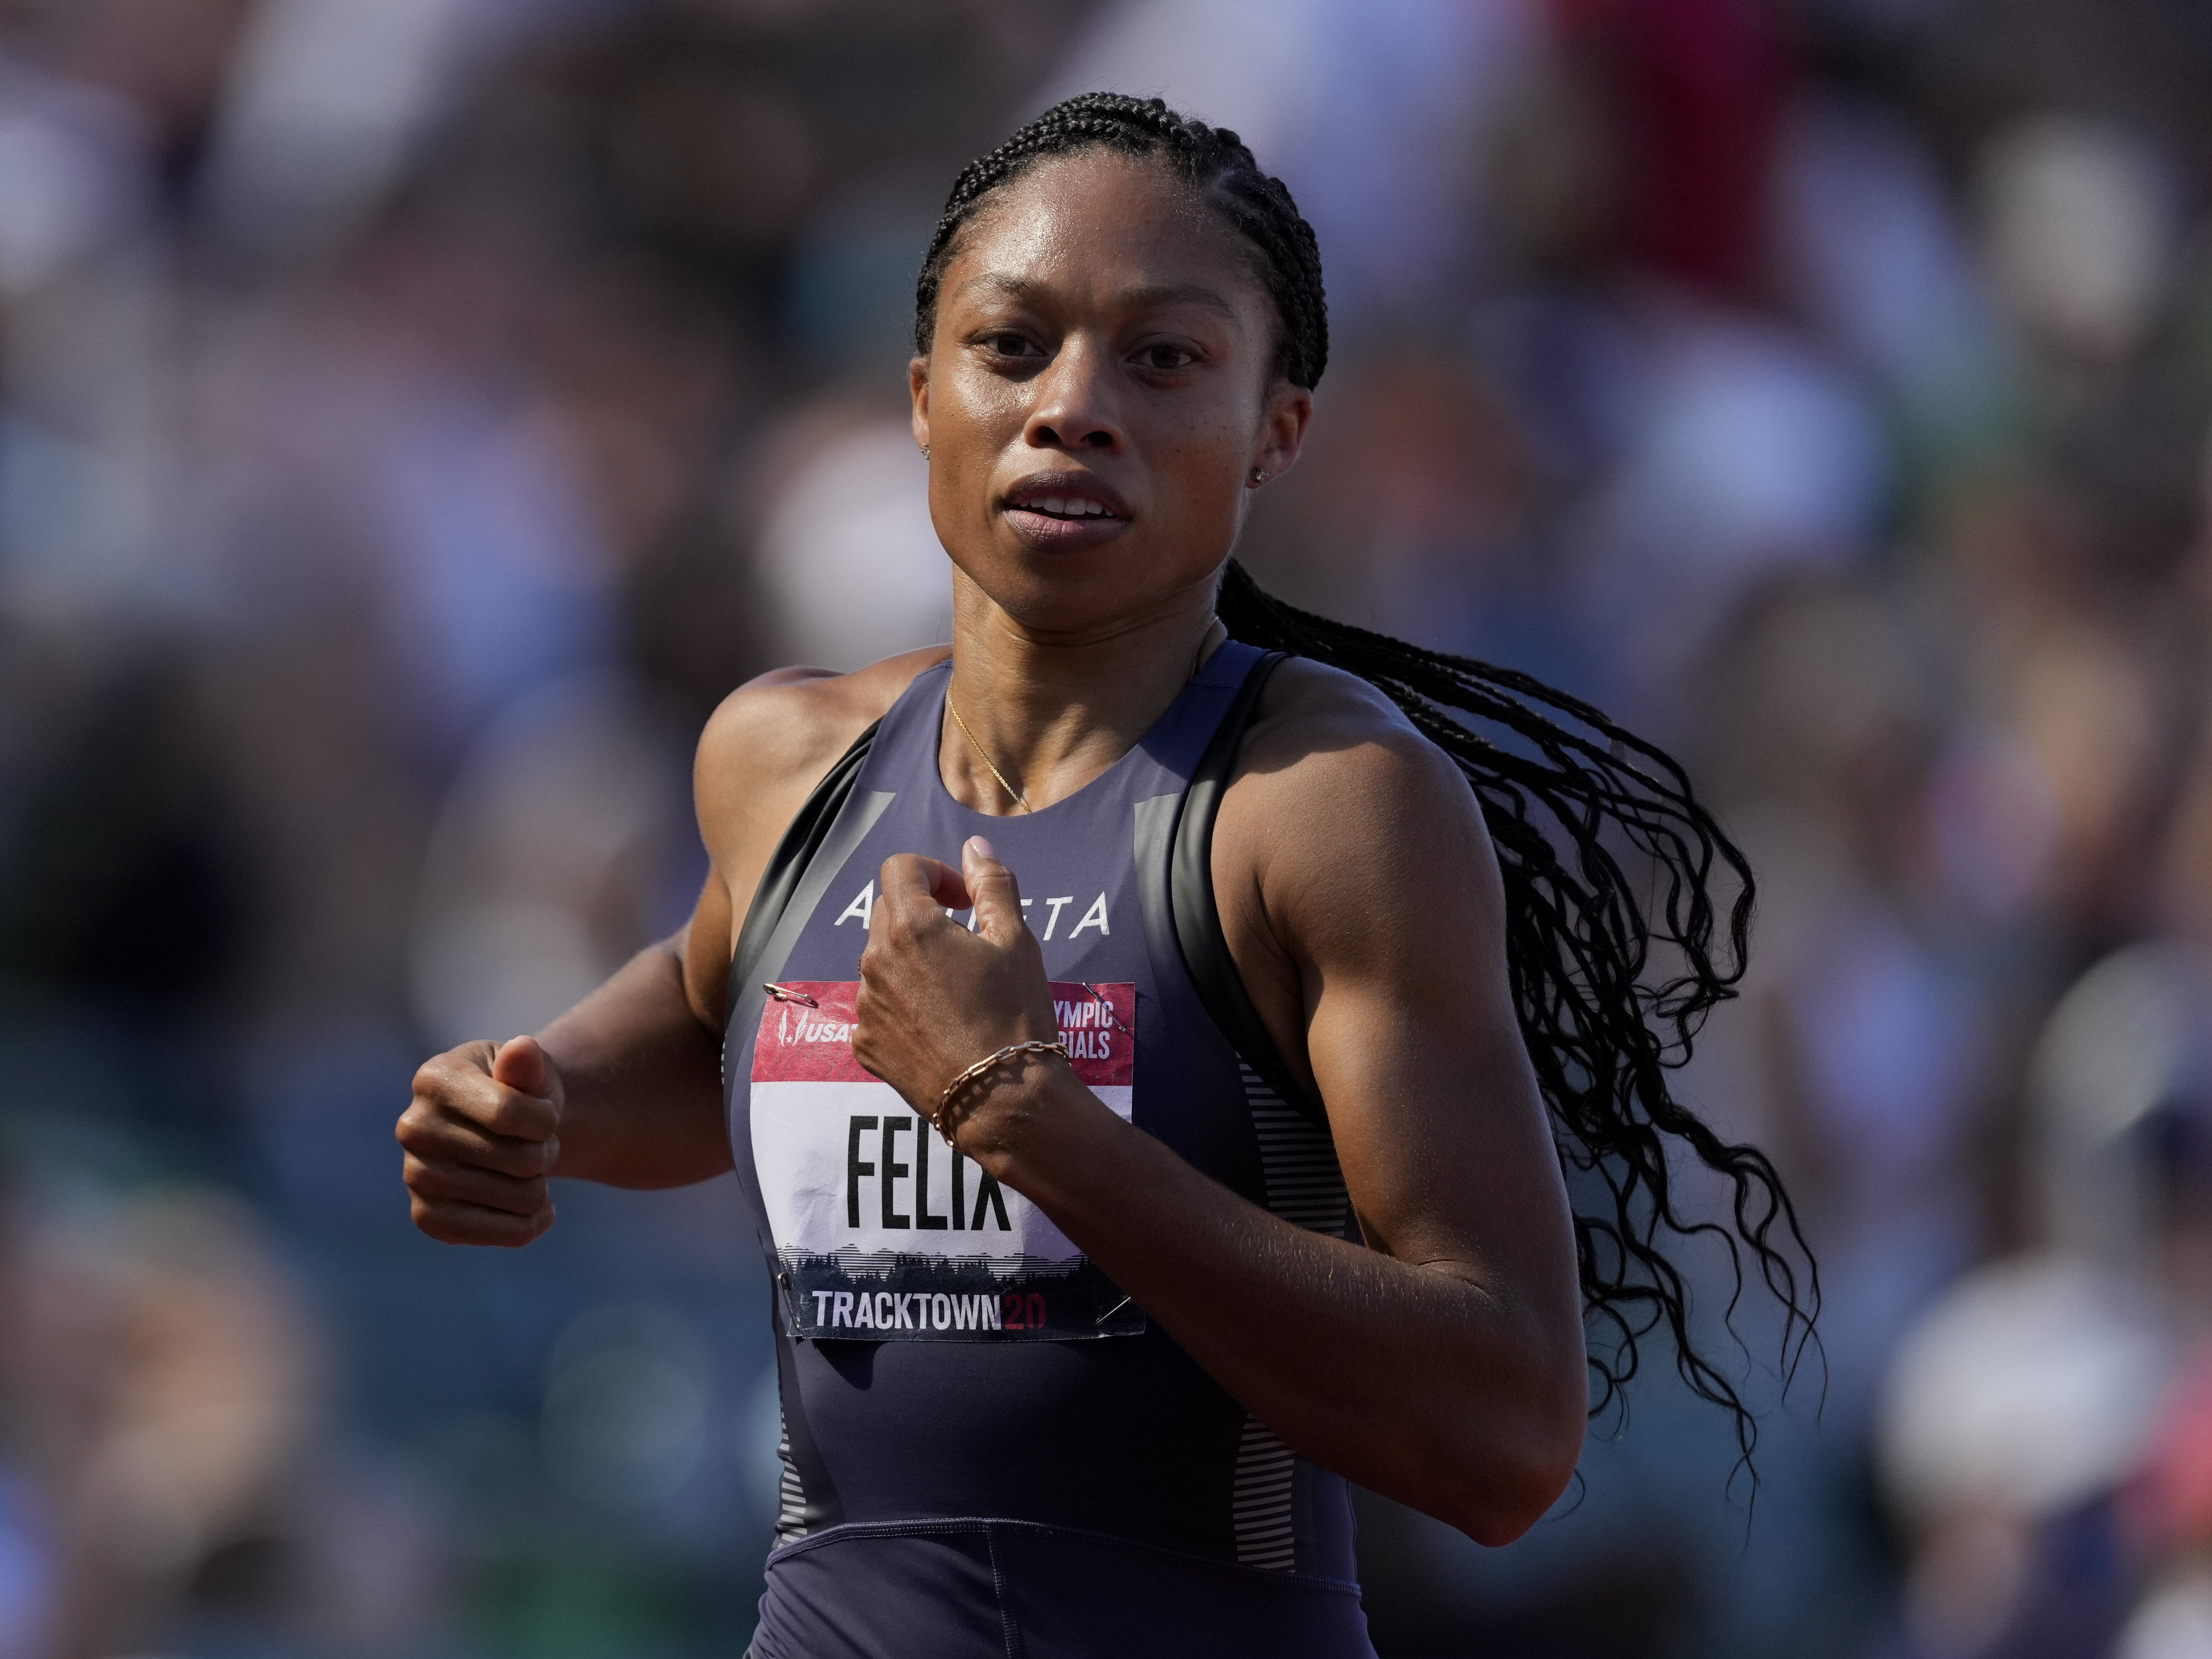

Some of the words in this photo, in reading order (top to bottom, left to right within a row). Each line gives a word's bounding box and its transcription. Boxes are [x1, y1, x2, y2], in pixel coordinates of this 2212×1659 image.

[1053, 1000, 1113, 1028] YMPIC
[805, 1023, 859, 1042] USA
[847, 1116, 1012, 1230] FELIX
